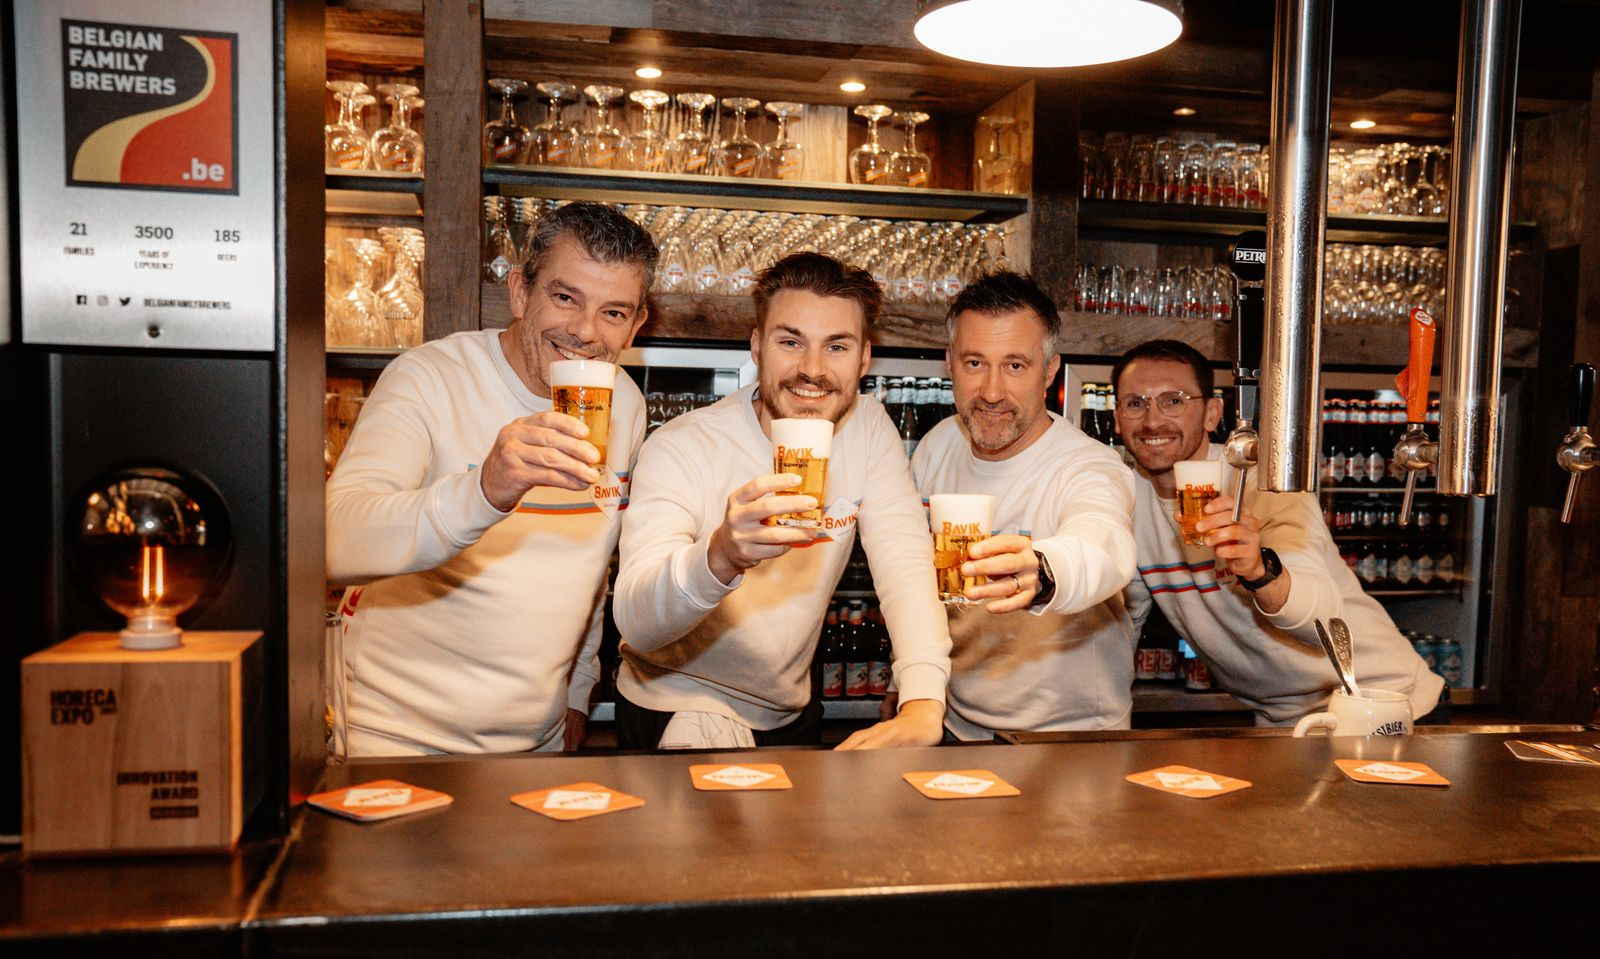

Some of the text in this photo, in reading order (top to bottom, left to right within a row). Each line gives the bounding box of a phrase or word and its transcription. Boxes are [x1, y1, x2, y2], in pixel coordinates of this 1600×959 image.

[68, 25, 164, 51] BELGIAN
[69, 48, 149, 72] FAMILY
[69, 70, 177, 96] BREWERS
[182, 158, 225, 182] .be
[69, 222, 88, 236] 21
[134, 225, 174, 240] 3500
[214, 230, 241, 243] 185
[50, 688, 117, 706] HORECA
[51, 707, 95, 726] EXPO
[1372, 721, 1403, 736] STBIER
[117, 771, 199, 786] INNOVATION
[151, 786, 199, 801] AWARD
